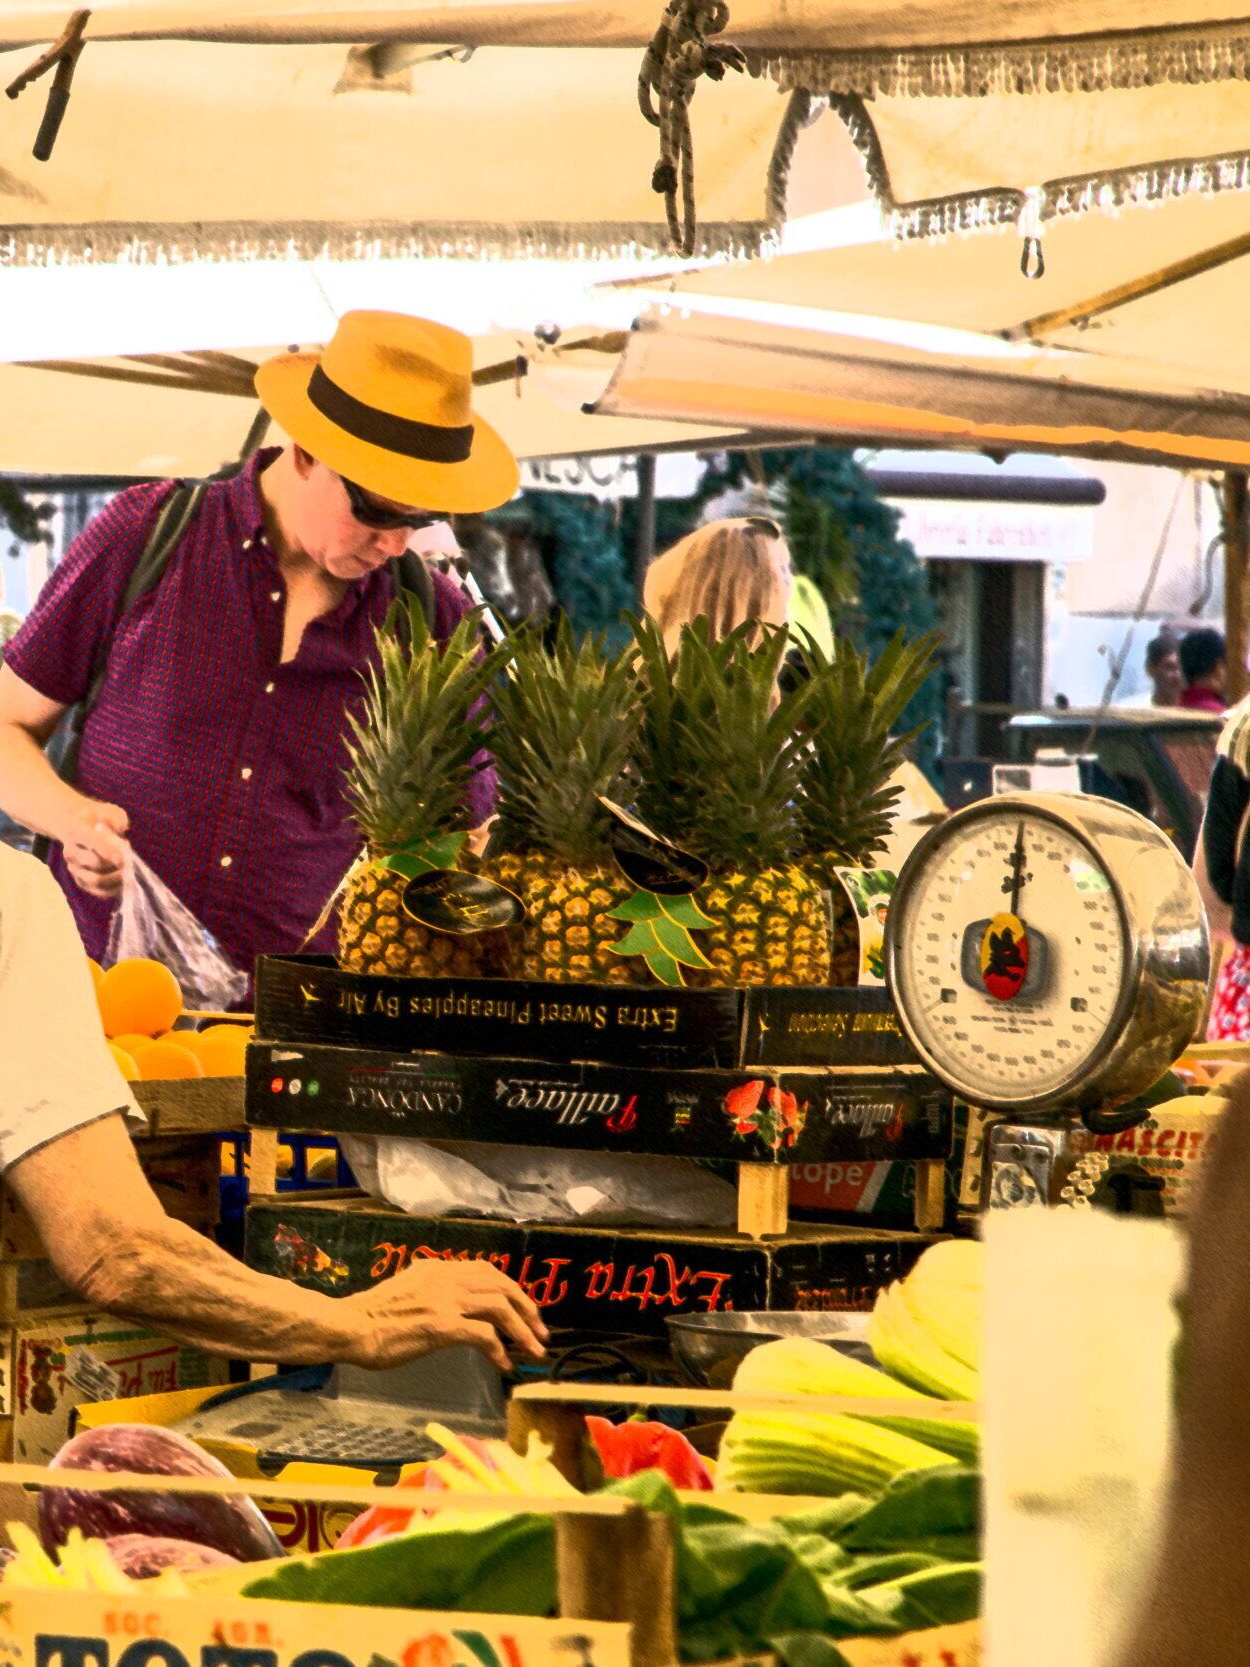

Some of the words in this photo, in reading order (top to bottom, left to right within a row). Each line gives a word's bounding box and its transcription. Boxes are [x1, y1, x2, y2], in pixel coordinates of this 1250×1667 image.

[338, 991, 368, 1017] Air
[373, 990, 400, 1019] By
[409, 987, 531, 1026] Pineapples
[539, 1002, 608, 1029] Sweet
[617, 1005, 679, 1033] Extra
[583, 1251, 733, 1313] Extra
